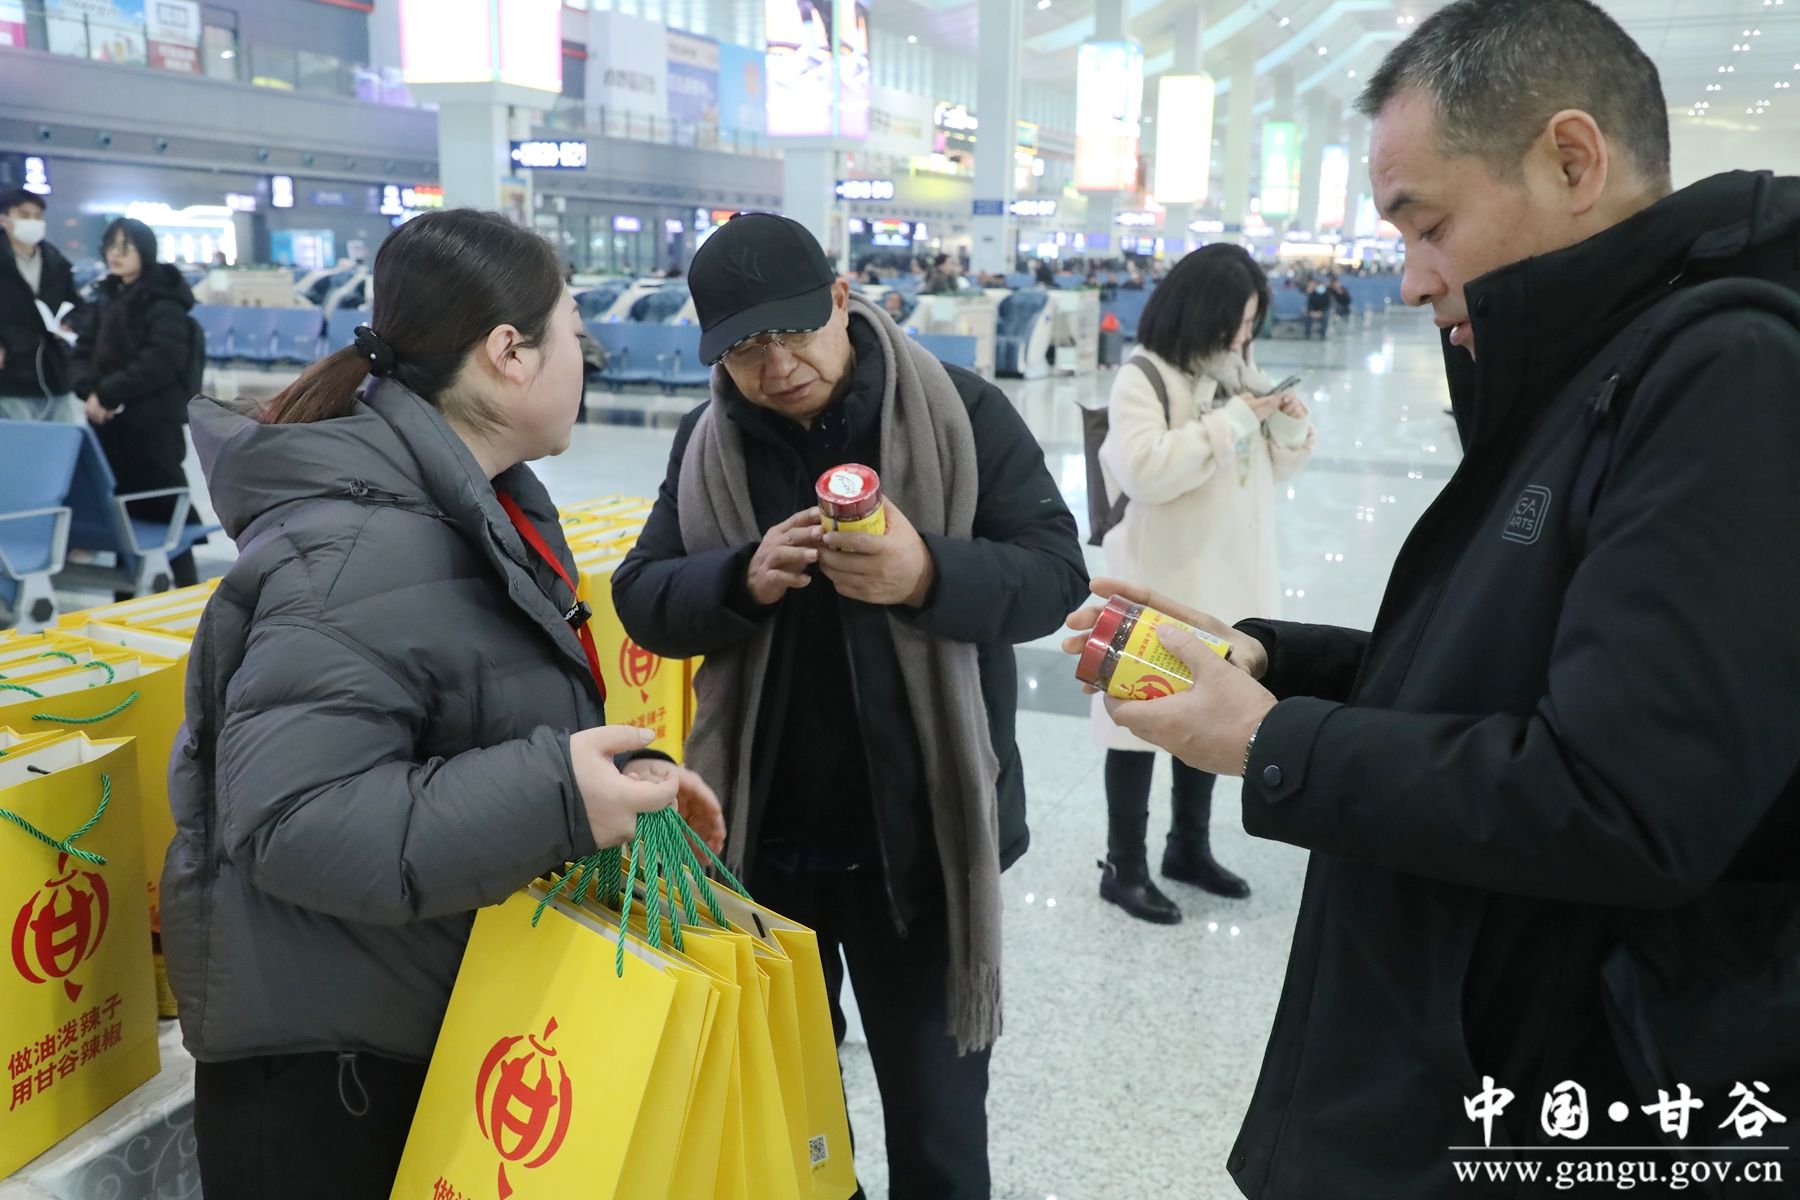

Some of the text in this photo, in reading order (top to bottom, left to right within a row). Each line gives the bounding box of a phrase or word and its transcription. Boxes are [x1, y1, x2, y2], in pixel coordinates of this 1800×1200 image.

[1510, 516, 1535, 531] ARTS
[8, 993, 122, 1081] 做油泼辣子
[9, 1021, 122, 1112] 用甘谷辣椒
